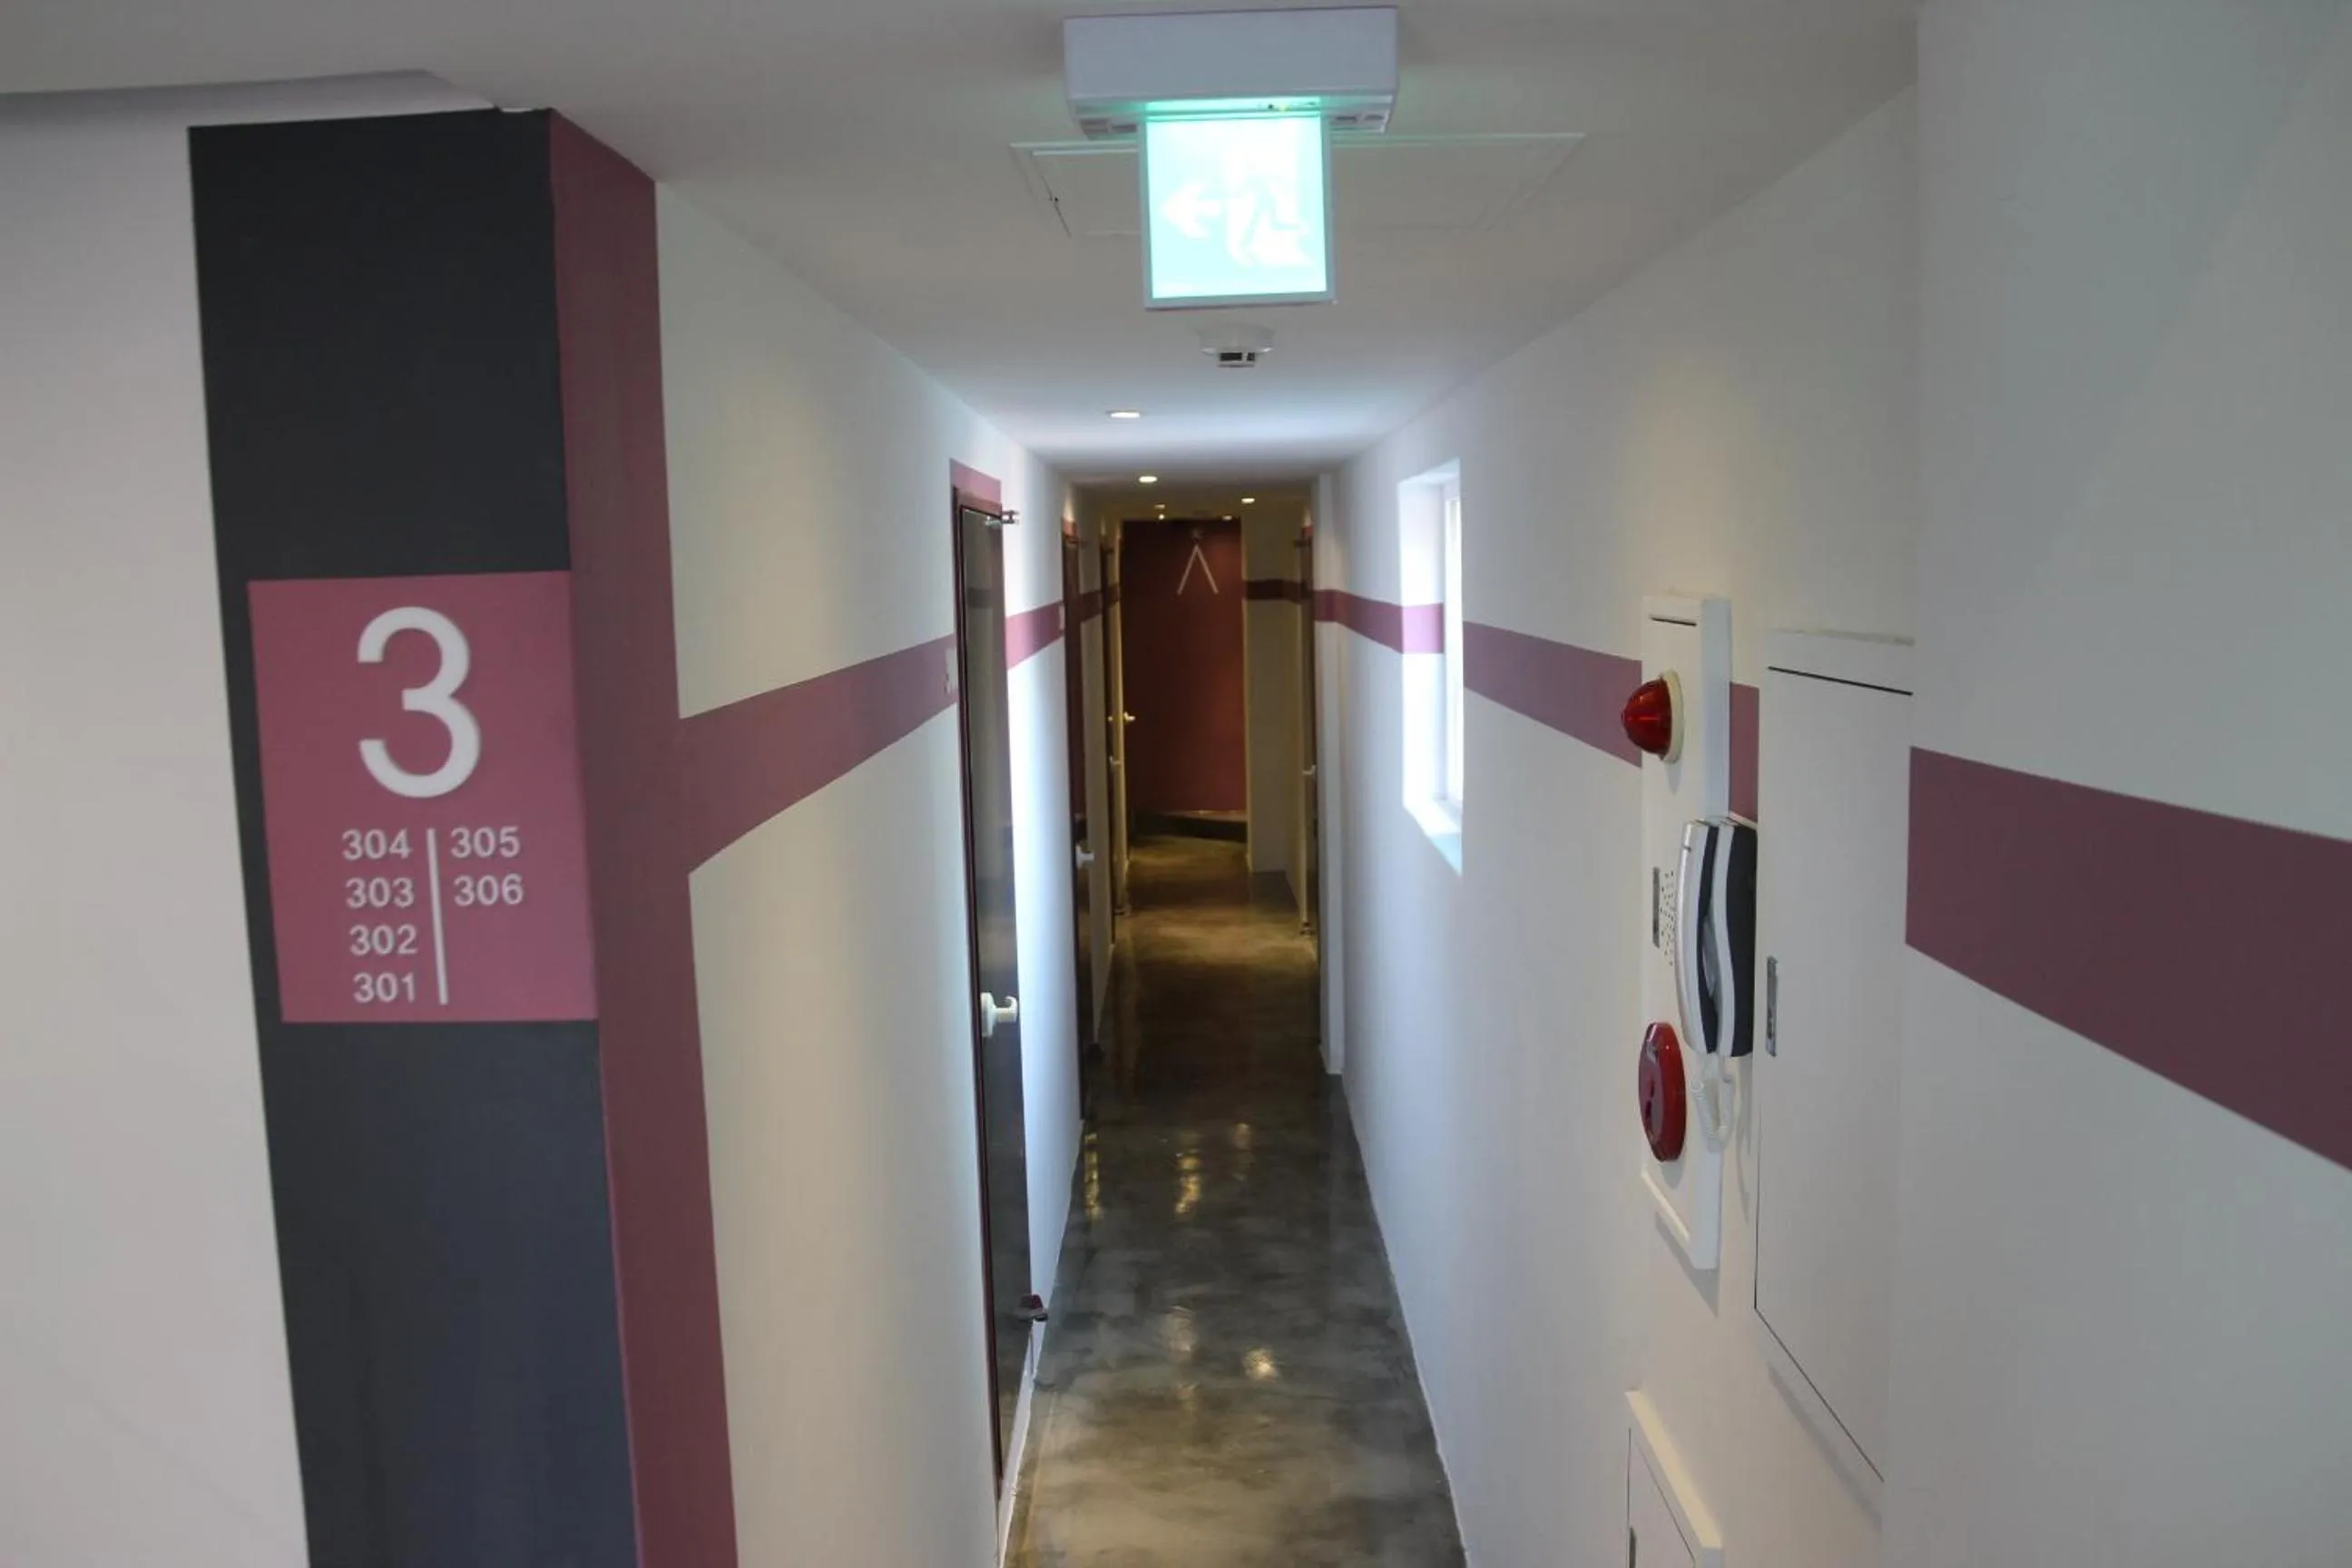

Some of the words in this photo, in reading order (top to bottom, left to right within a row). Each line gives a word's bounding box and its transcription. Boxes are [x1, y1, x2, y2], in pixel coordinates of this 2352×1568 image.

[357, 606, 482, 799] 3
[342, 828, 412, 860] 304
[450, 826, 521, 858] 305
[346, 877, 416, 908] 303
[453, 873, 524, 906] 306
[349, 924, 418, 956] 302
[353, 972, 416, 1004] 301
